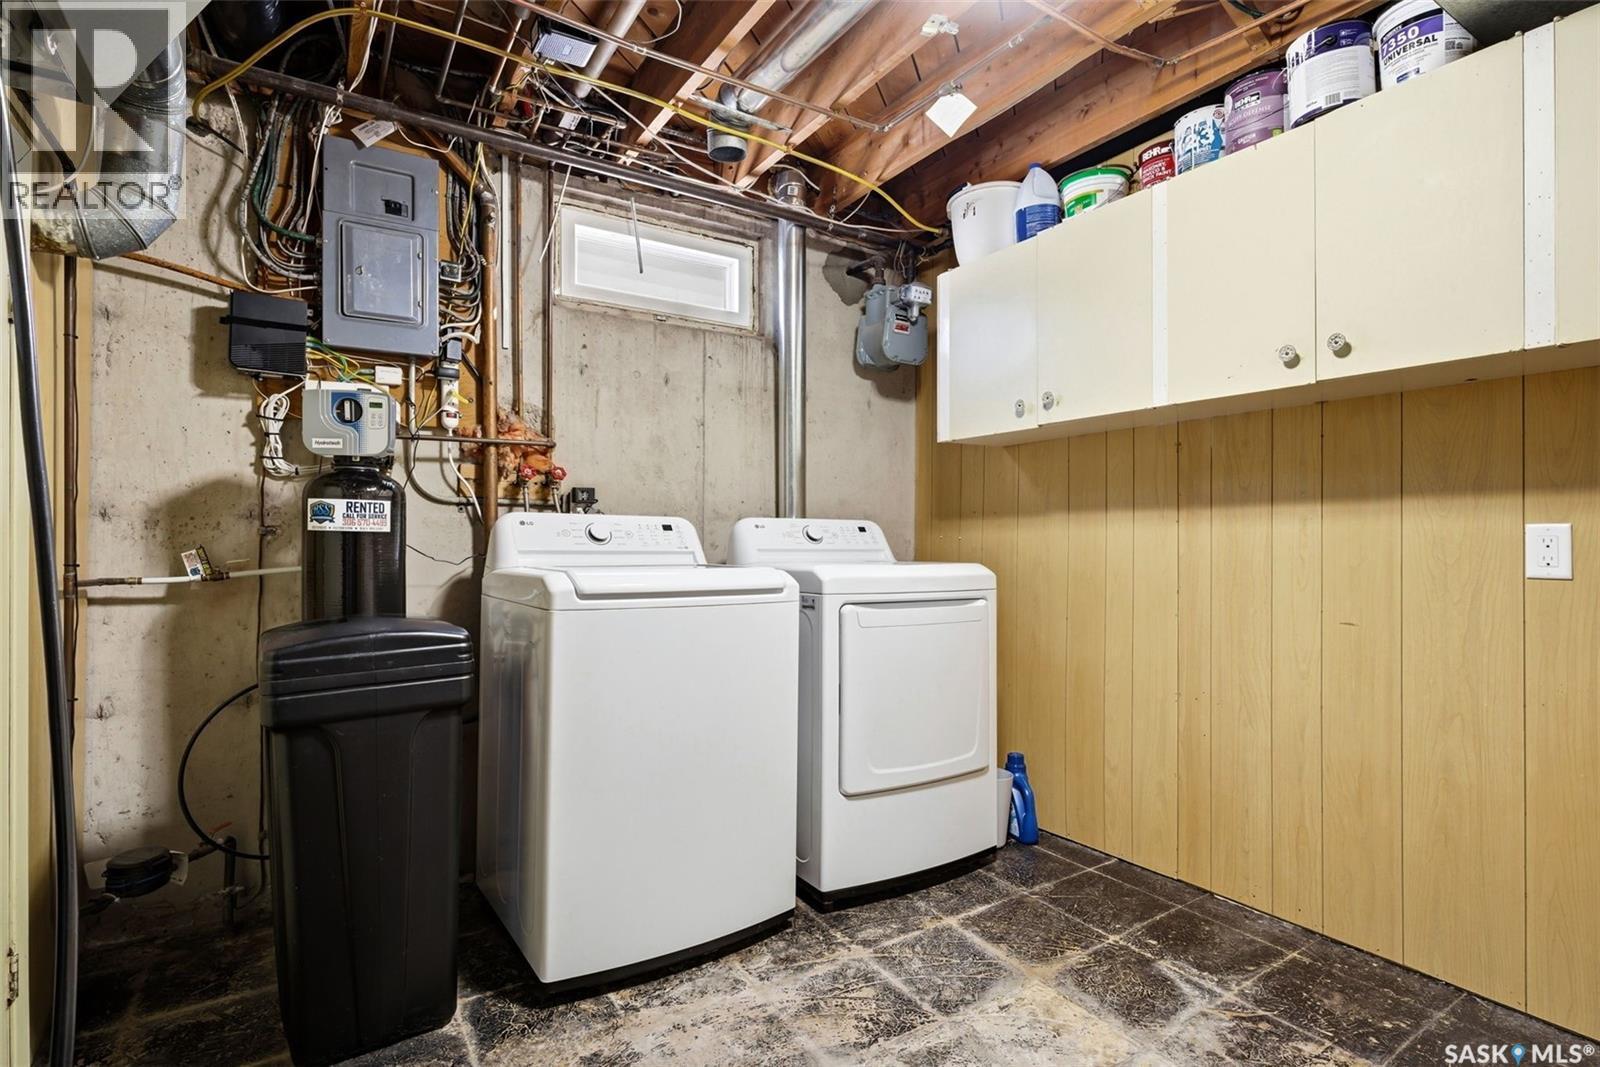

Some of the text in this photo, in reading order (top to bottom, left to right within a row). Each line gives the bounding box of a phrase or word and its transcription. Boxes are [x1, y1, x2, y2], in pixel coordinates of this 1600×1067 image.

[1381, 25, 1420, 57] 7350
[1383, 34, 1438, 66] UNIVERSAL
[1142, 146, 1160, 161] BEHR
[346, 501, 385, 514] RENTED
